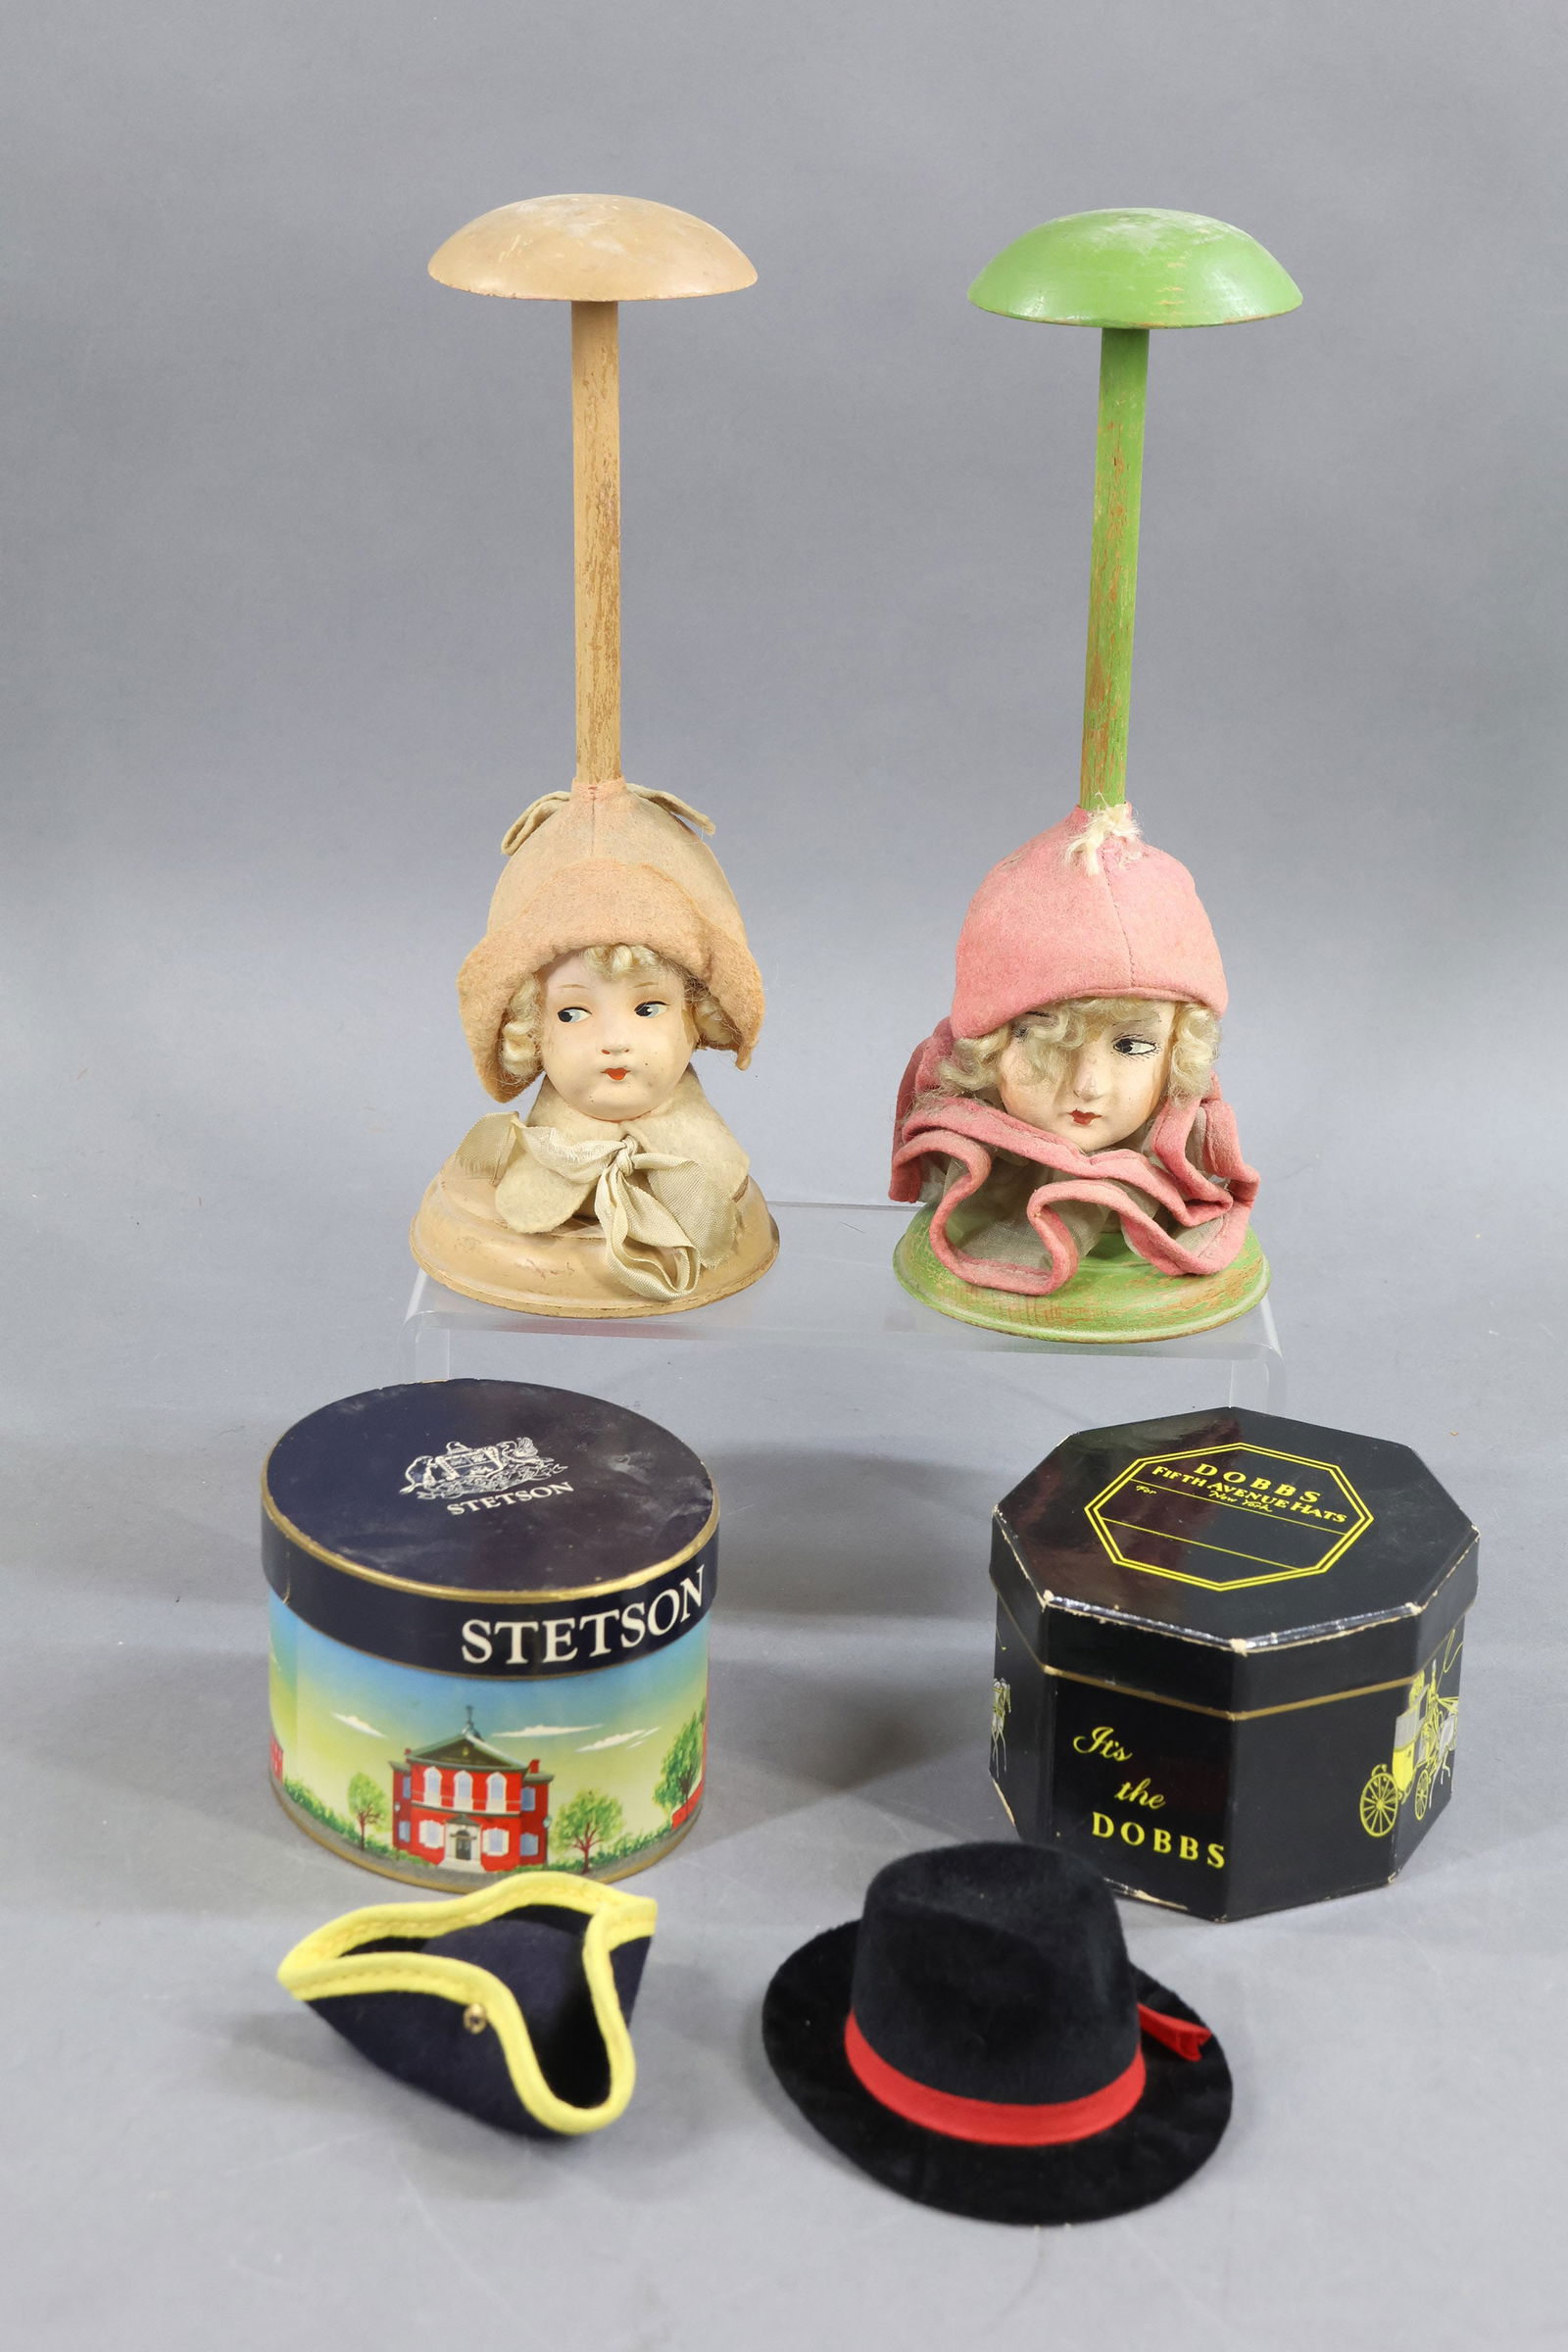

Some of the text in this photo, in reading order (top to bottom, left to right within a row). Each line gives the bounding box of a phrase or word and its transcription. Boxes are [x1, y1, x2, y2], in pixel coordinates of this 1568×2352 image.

[447, 1481, 575, 1516] STETSON
[1135, 1485, 1157, 1495] For
[1152, 1465, 1348, 1524] FIFTH AVENUE HATS
[1194, 1463, 1321, 1503] DOBBS
[1208, 1490, 1238, 1503] New
[462, 1564, 705, 1665] STETSON
[1073, 1726, 1133, 1762] It's
[1114, 1778, 1166, 1810] the
[1092, 1811, 1225, 1869] DOBBS
